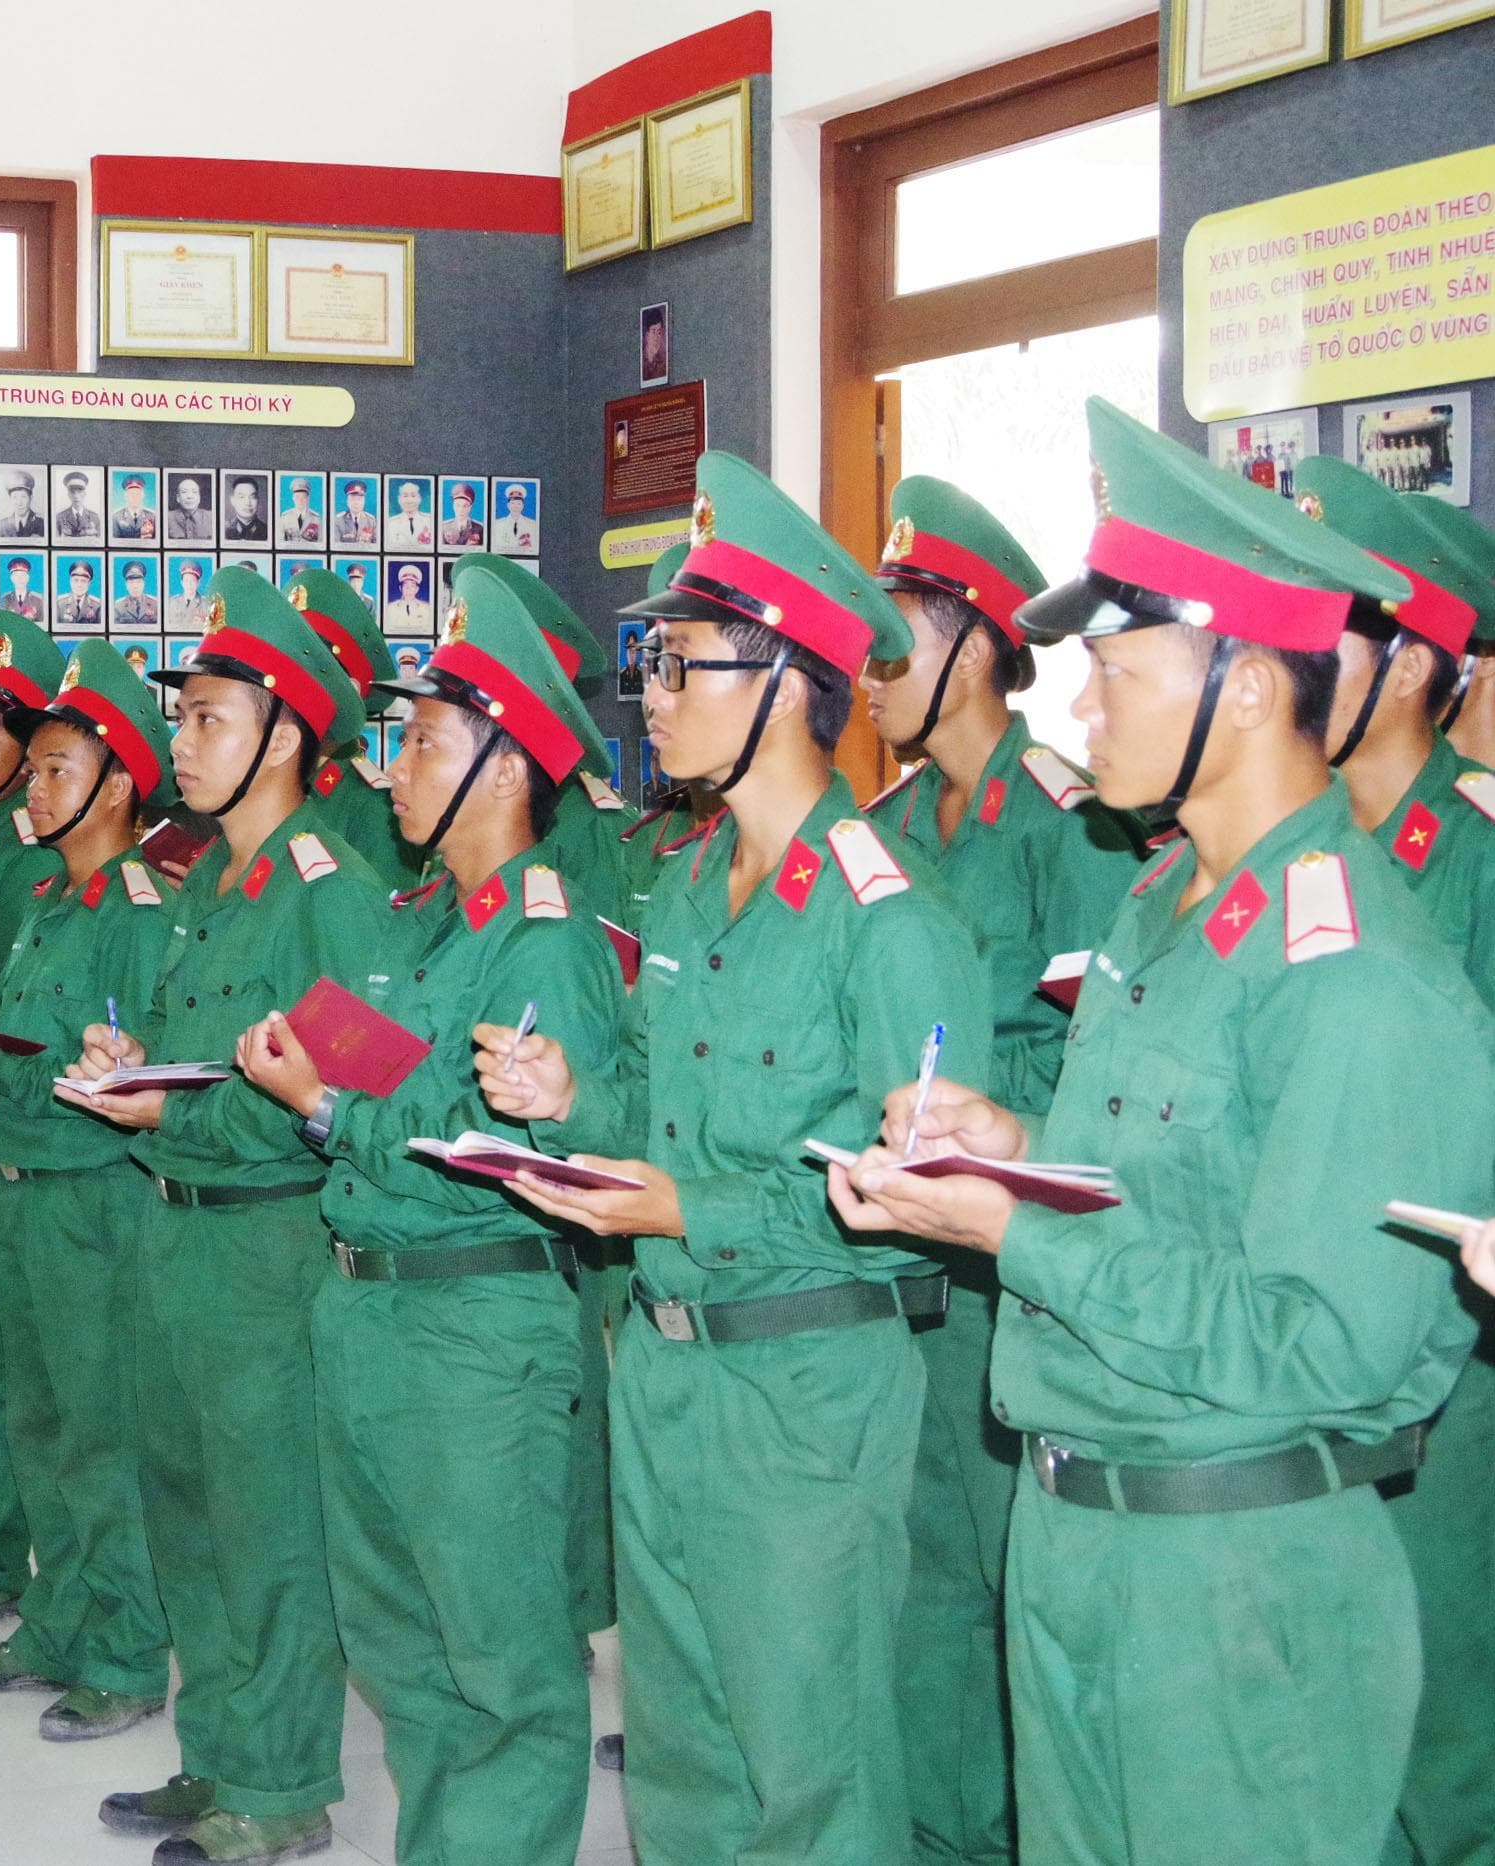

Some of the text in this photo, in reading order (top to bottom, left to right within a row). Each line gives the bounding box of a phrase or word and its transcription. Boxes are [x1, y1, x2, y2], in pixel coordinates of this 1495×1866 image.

[1303, 221, 1367, 251] TRUNG
[1373, 205, 1430, 236] ĐOÀN
[1435, 192, 1492, 221] THEO
[1333, 256, 1380, 284] QUY,
[1385, 246, 1431, 272] TINH
[1346, 323, 1405, 356] QUỐC
[71, 387, 125, 408] ĐOÀN
[130, 392, 169, 409] QUA
[175, 391, 213, 410] CÁC
[219, 392, 262, 412] THỜI
[268, 394, 293, 413] KỲ
